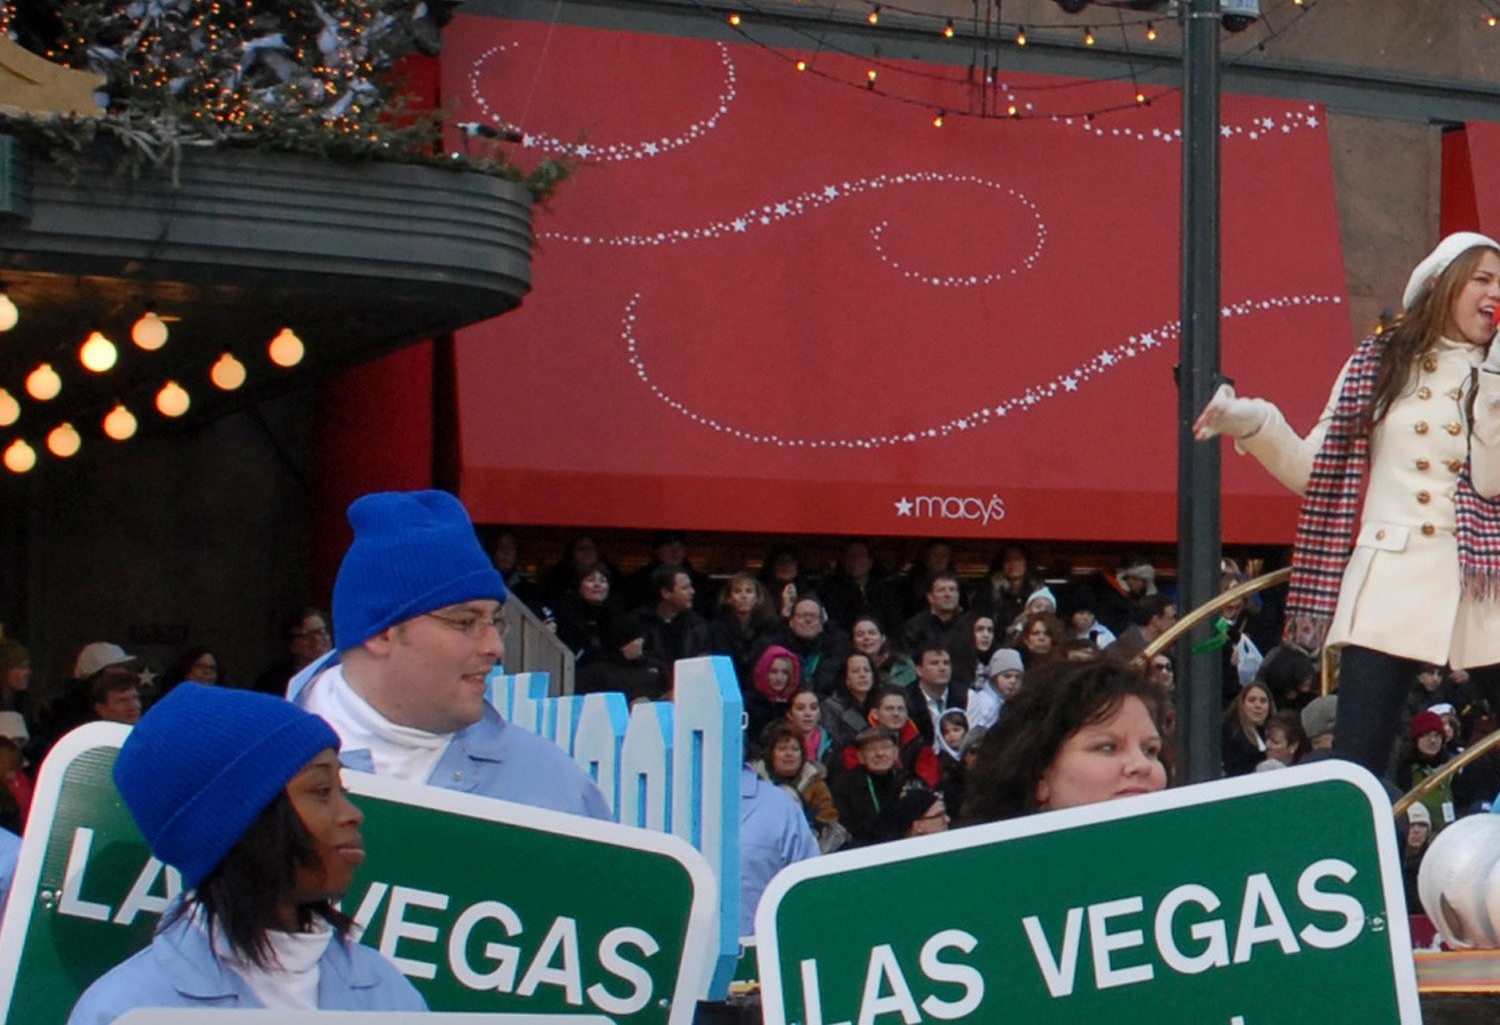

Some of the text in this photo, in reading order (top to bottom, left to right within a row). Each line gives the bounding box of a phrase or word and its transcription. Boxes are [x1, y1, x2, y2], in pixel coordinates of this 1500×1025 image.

[57, 826, 184, 925] LA
[800, 857, 1366, 1025] LAS VEGAS
